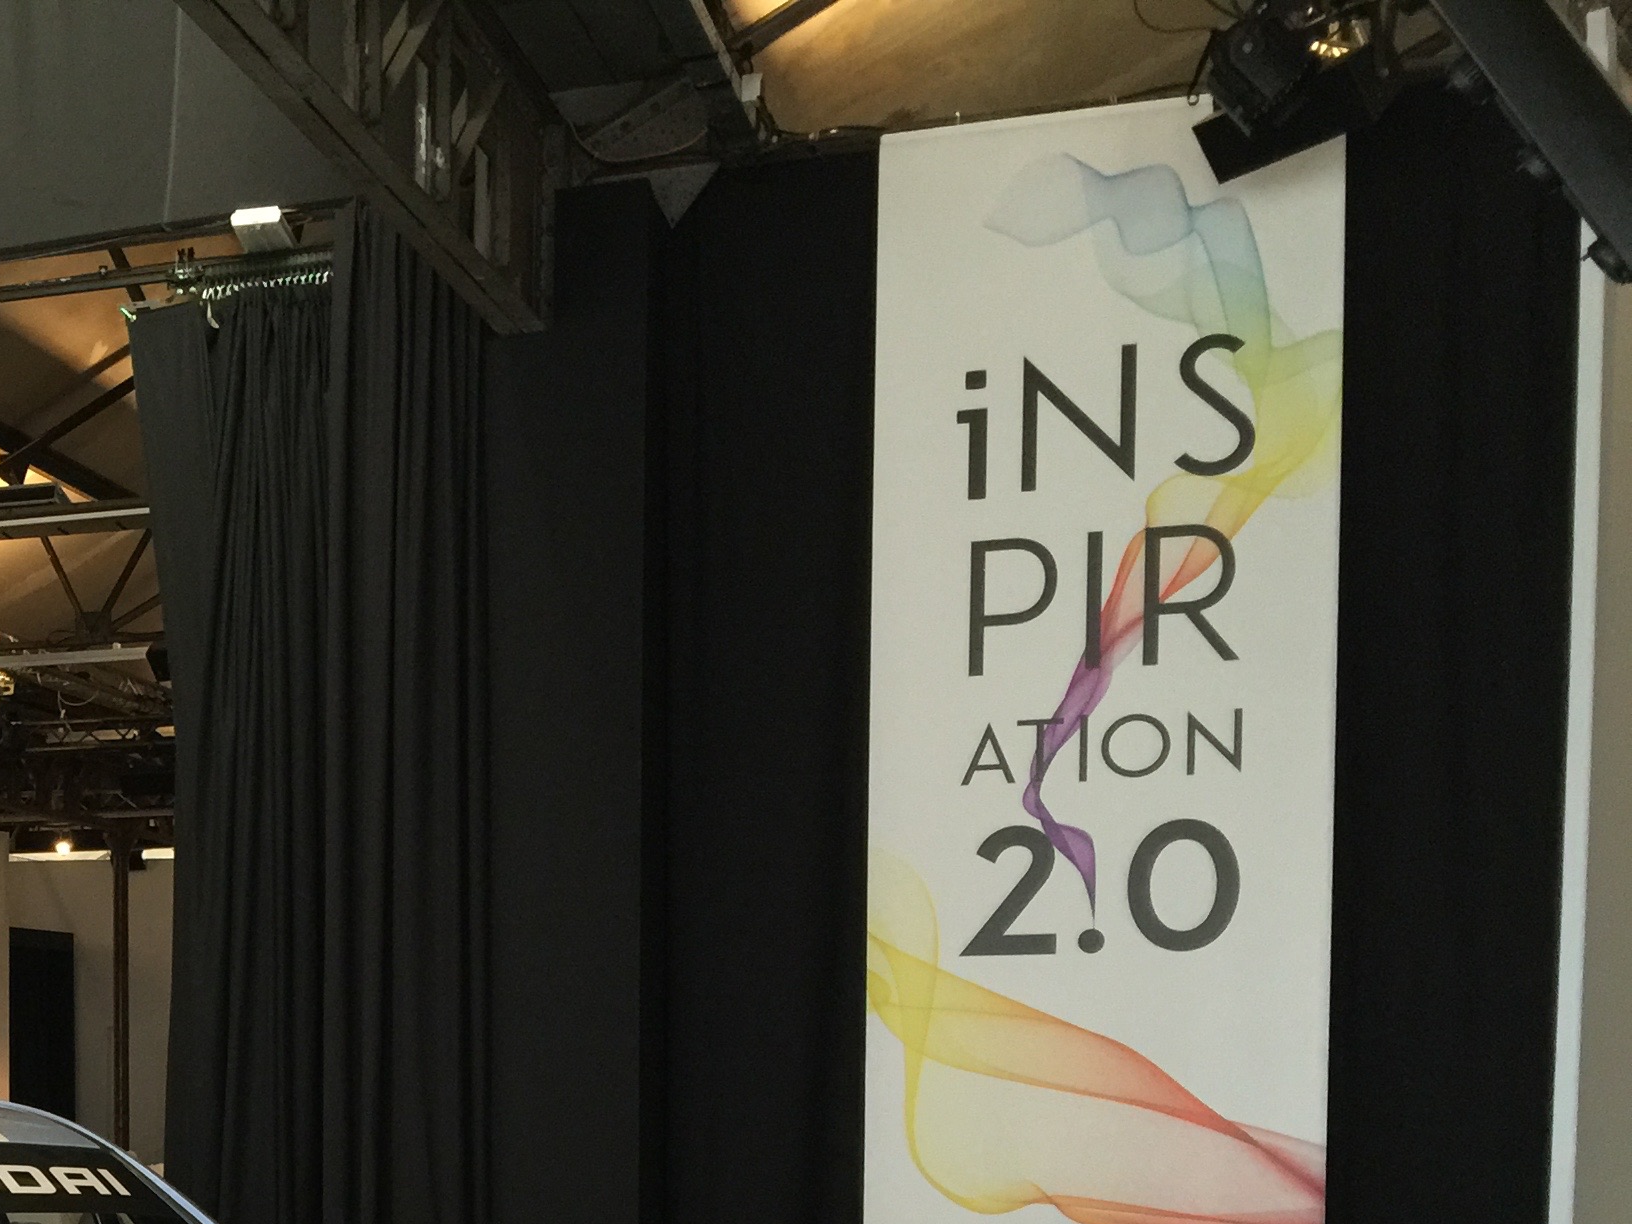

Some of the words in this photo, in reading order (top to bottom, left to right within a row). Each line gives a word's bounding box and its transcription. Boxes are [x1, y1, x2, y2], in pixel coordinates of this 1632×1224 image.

[956, 333, 1257, 500] iNS
[968, 523, 1240, 677] PIR
[960, 708, 1244, 786] ATION
